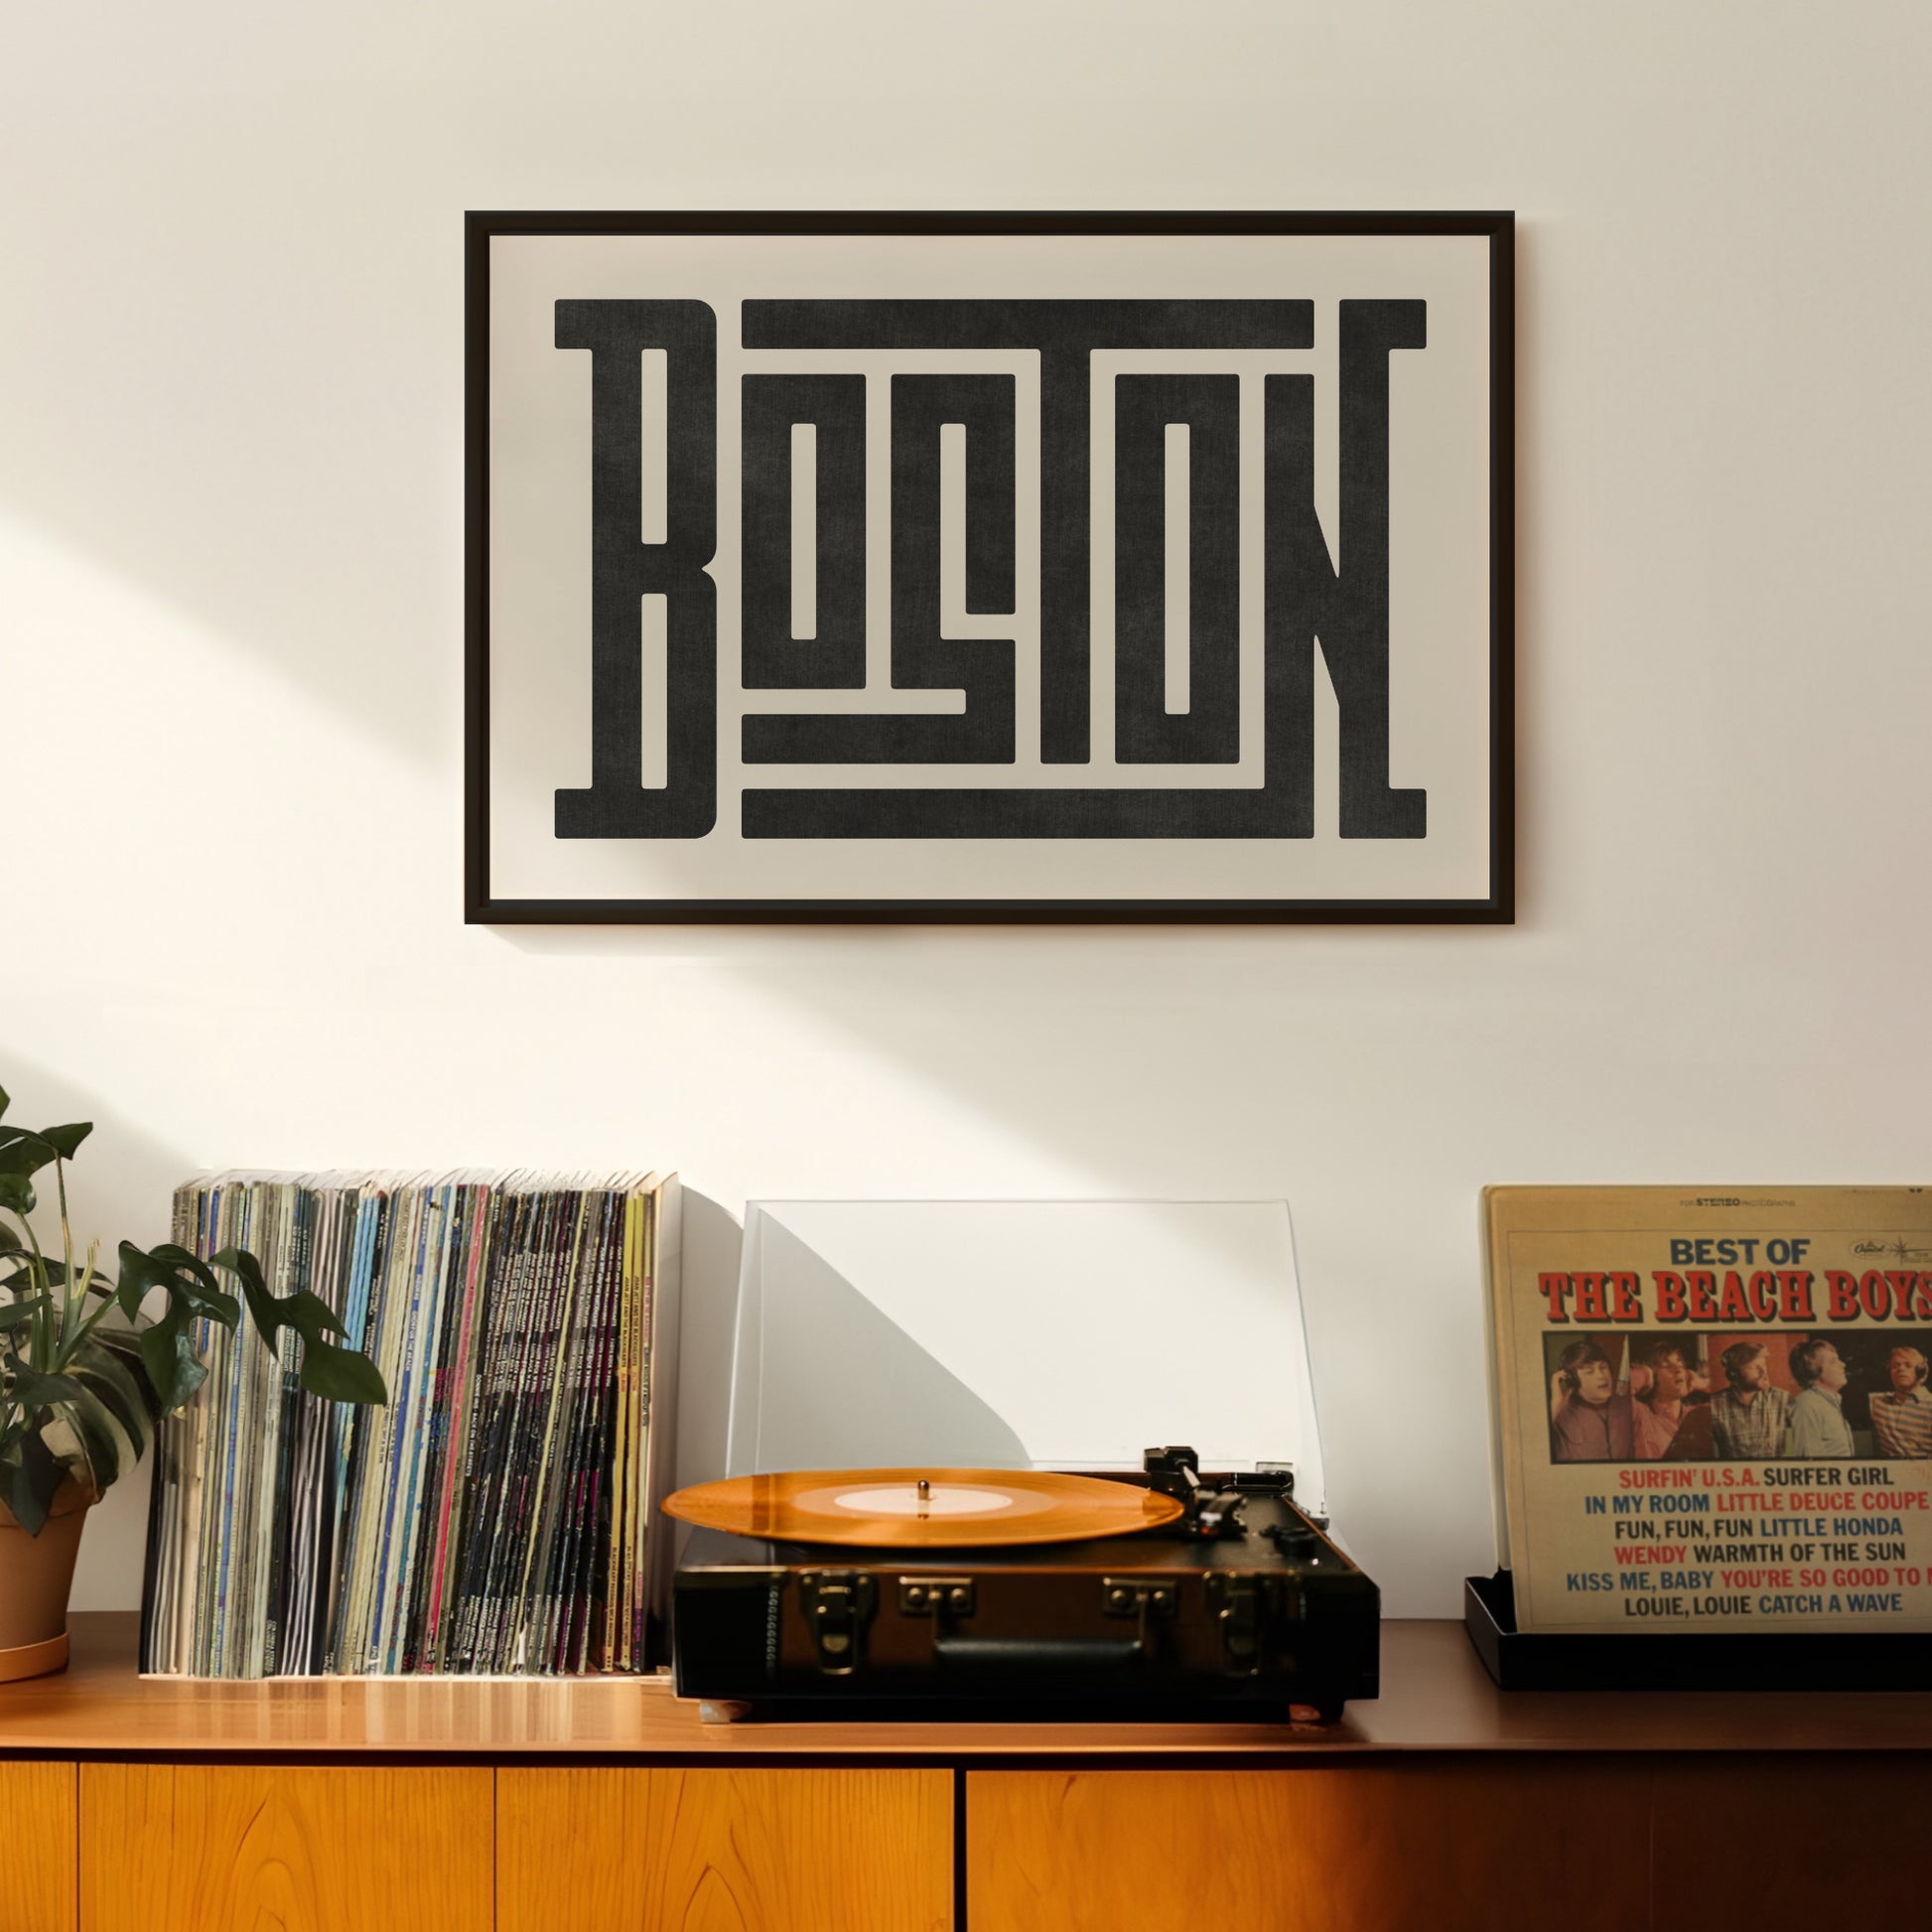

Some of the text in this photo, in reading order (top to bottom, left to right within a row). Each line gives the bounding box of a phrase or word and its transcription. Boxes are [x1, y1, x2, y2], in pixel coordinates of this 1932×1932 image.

[554, 299, 1427, 839] BOSTON
[1670, 1239, 1811, 1265] BEST OF
[1539, 1271, 1644, 1322] THE
[1653, 1271, 1816, 1321] BEACH
[1619, 1466, 1893, 1488] SURFIN' U.S.A. SURFER GIRL
[1586, 1492, 1930, 1515] IN MY ROOM LITTLE DEUCE COUPE
[1615, 1517, 1902, 1542] FUN, FUN, FUN LITTLE HONDA
[1614, 1543, 1906, 1566] WENDY WARMTH OF THE SUN
[1567, 1573, 1613, 1591] KISS
[1620, 1572, 1657, 1594] ME,
[1661, 1571, 1714, 1589] BABY
[1721, 1570, 1793, 1588] YOU'RE
[1800, 1570, 1827, 1587] SO
[1832, 1569, 1890, 1587] GOOD
[1896, 1568, 1922, 1586] TO
[1625, 1593, 1902, 1619] LOUIE, LOUIE CATCH A WAVE
